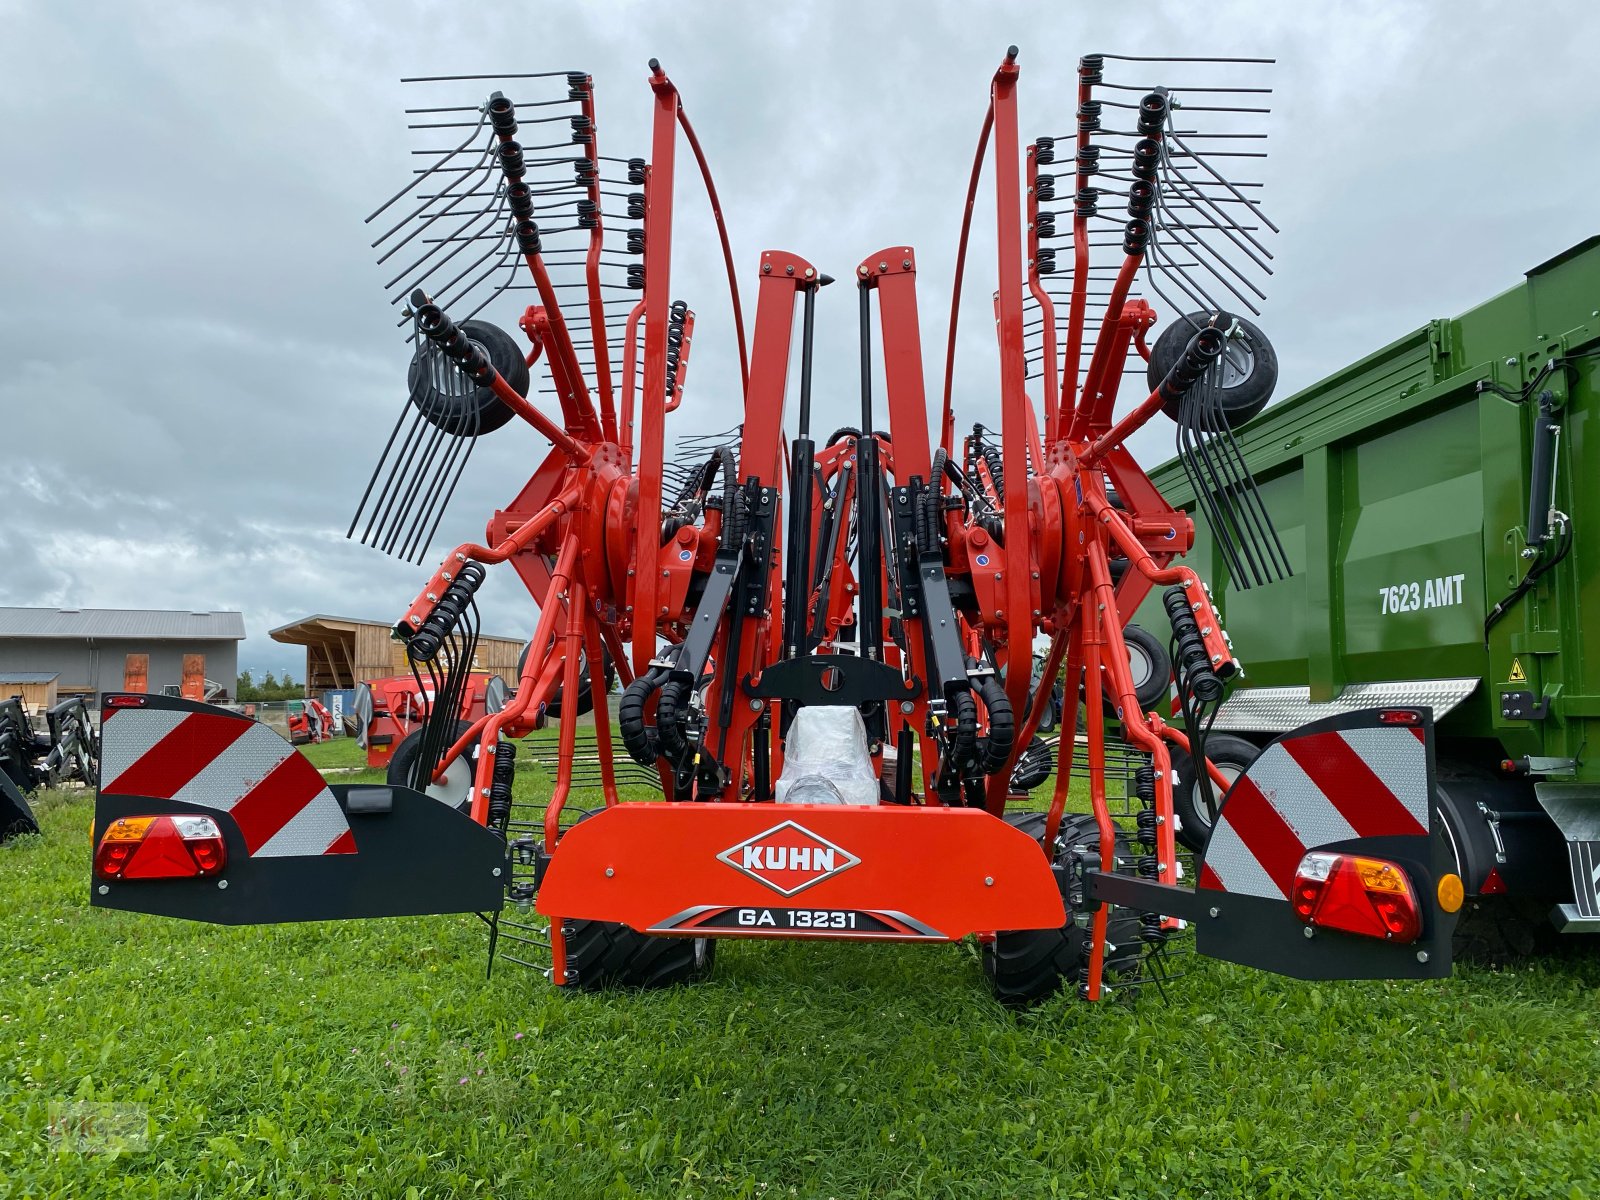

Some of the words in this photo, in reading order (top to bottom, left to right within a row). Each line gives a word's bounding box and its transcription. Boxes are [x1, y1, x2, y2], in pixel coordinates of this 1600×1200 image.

[1379, 582, 1420, 615] 7623
[1423, 574, 1465, 609] AMT
[743, 845, 835, 872] KUHN
[738, 909, 776, 926] GA
[787, 910, 856, 929] 13231
